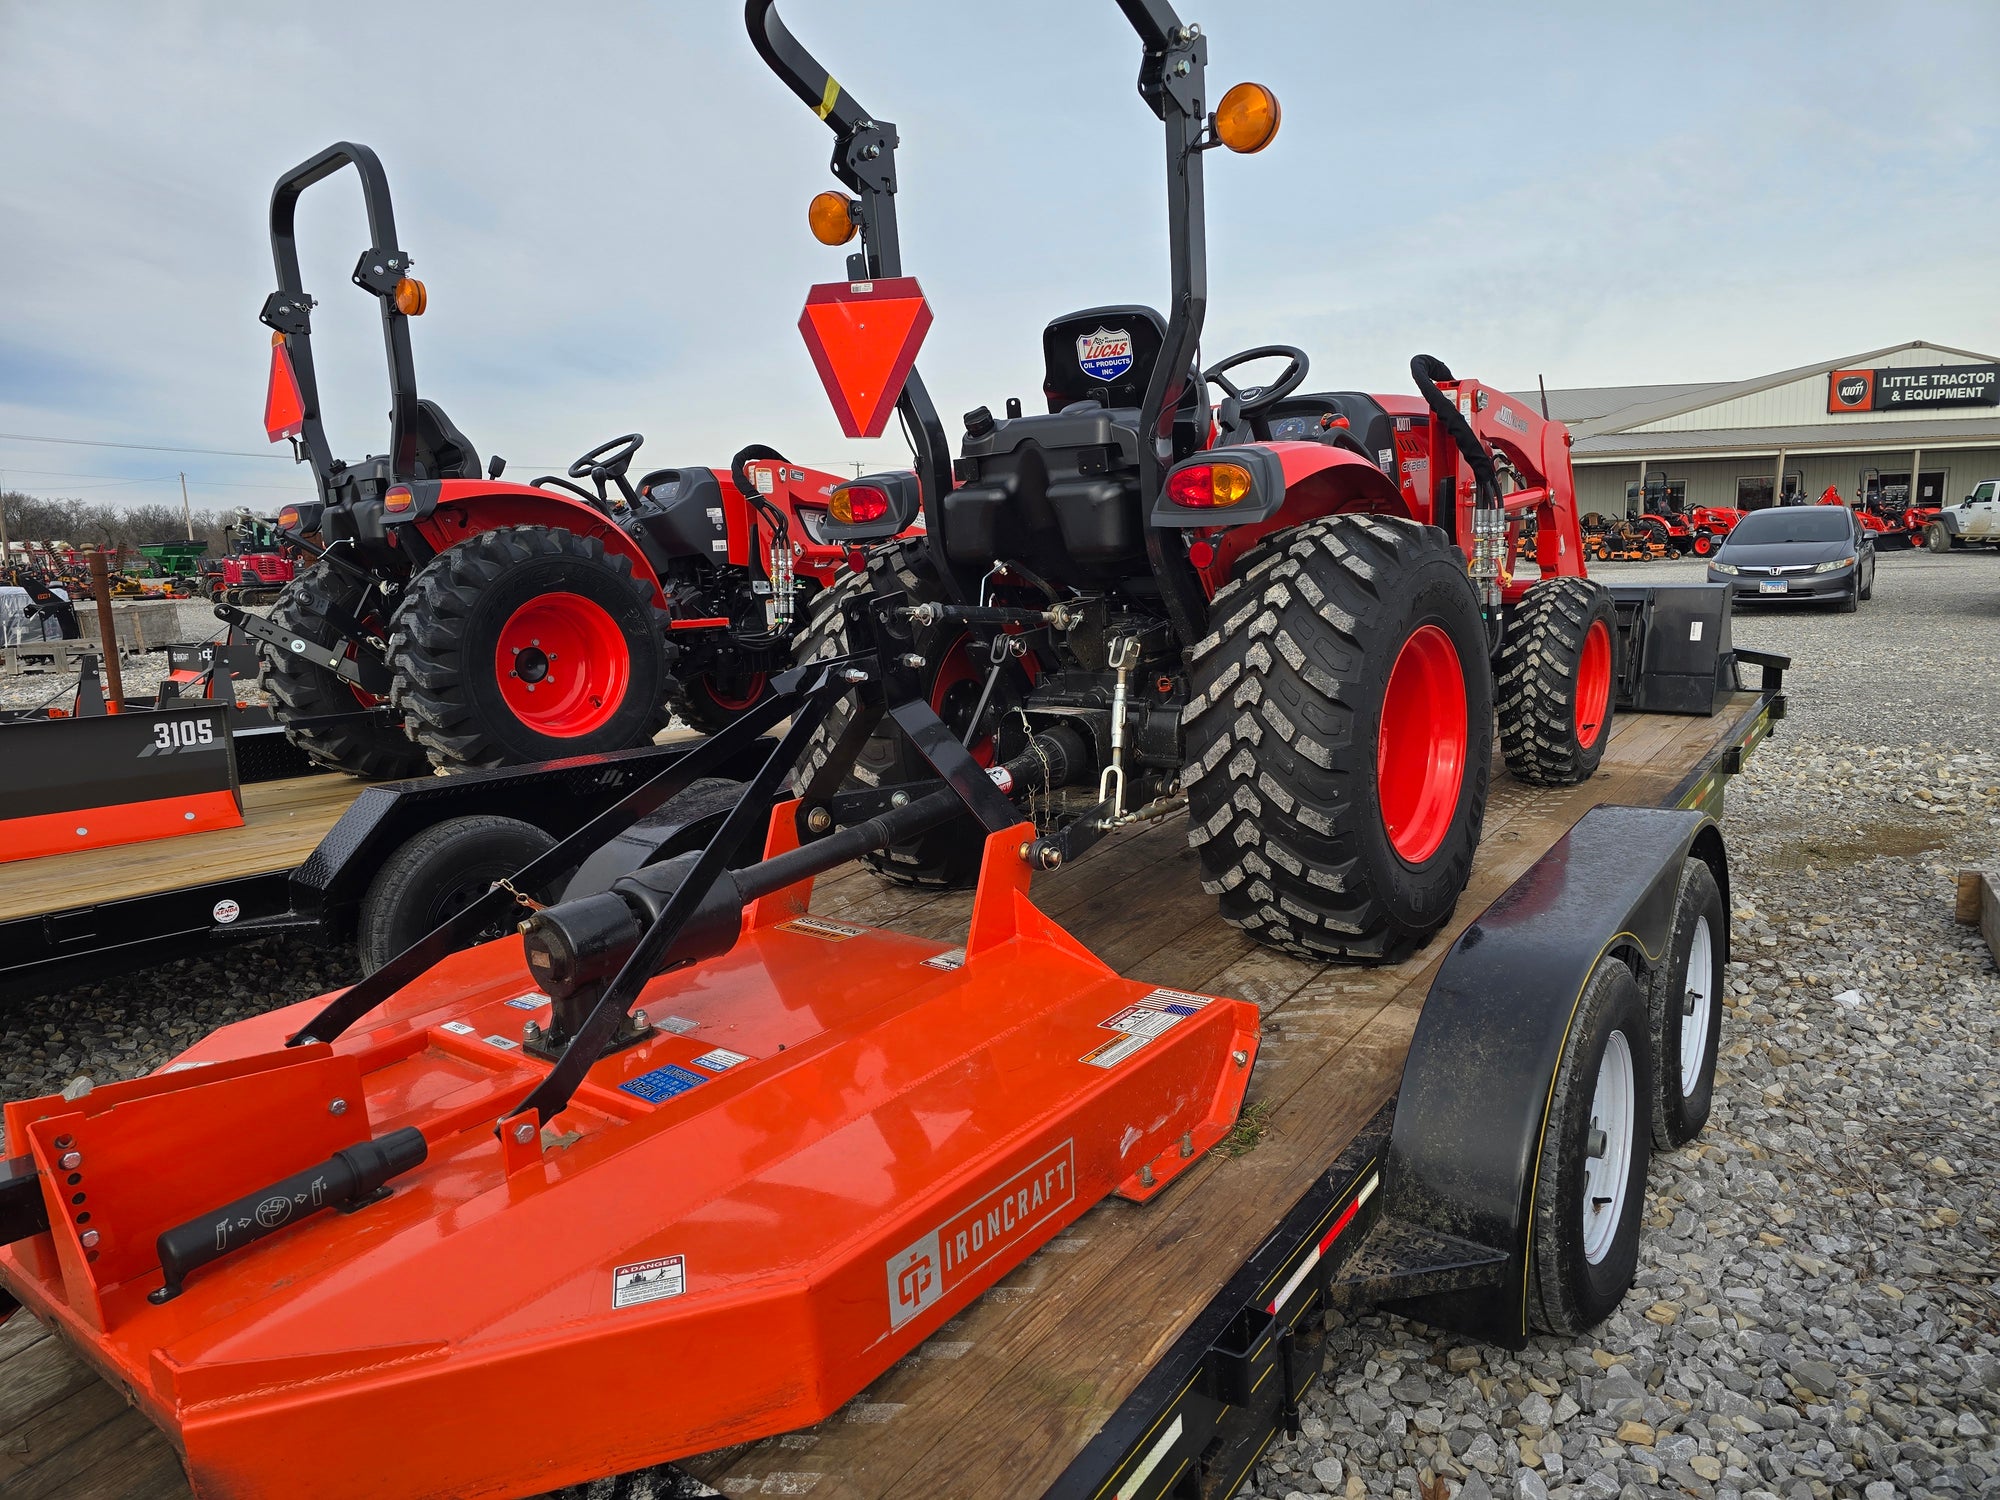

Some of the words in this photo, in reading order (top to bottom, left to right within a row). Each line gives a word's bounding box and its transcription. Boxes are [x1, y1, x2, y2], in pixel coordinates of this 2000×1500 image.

[1086, 342, 1128, 359] LUCAS
[1096, 358, 1130, 368] PRODUCTS
[1882, 375, 1928, 388] LITTLE
[1932, 372, 1995, 384] TRACTOR
[1842, 381, 1864, 396] KIOTI
[1891, 391, 1900, 401] &
[1905, 387, 1984, 401] EQUIPMENT
[1396, 418, 1411, 431] KIOTI
[798, 918, 840, 932] RIDERS
[840, 926, 862, 935] NO
[695, 1058, 726, 1070] NOTICE
[624, 1079, 661, 1098] YEAR
[654, 1092, 672, 1102] 5
[946, 1160, 1066, 1272] IRONCRAFT
[630, 1258, 678, 1272] DANGER
